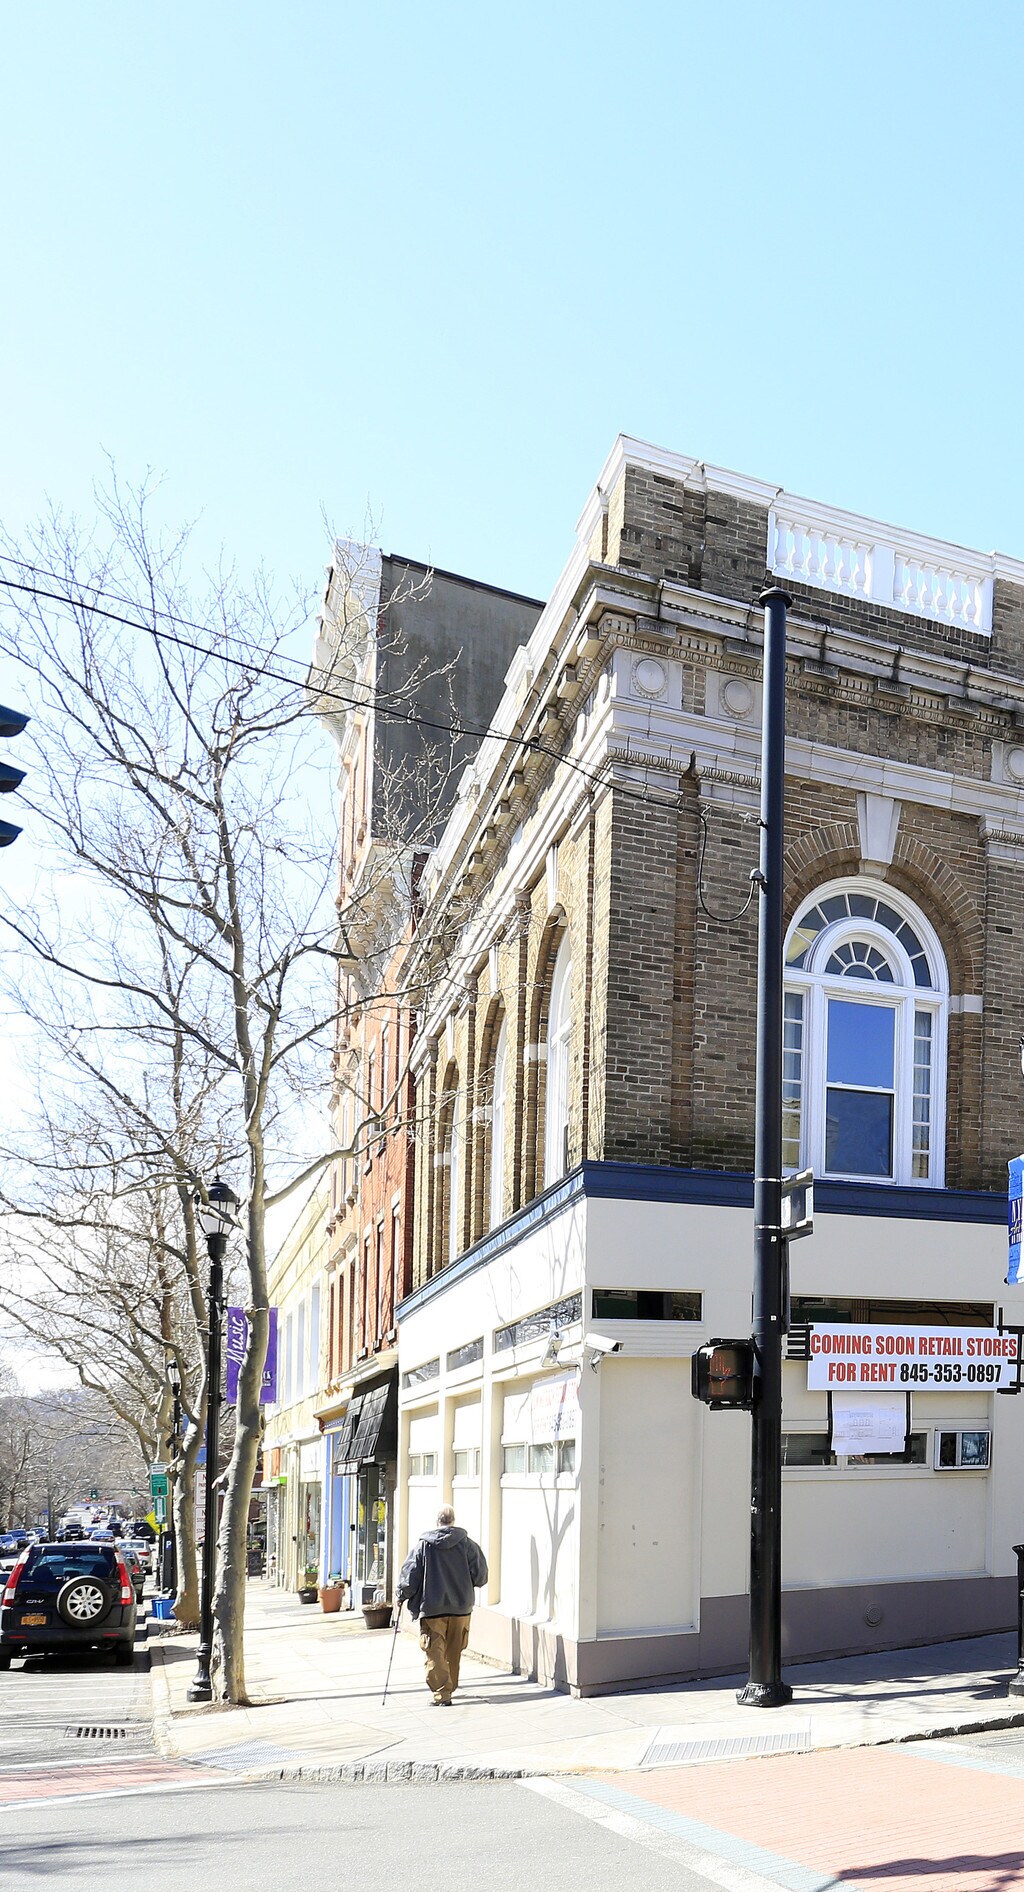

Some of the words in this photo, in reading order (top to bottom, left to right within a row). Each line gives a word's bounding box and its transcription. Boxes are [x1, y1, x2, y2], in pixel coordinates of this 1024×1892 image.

[226, 1316, 246, 1366] Music
[810, 1334, 872, 1355] COMING
[875, 1335, 915, 1355] SOON
[919, 1336, 963, 1356] RETAIL
[966, 1337, 1017, 1357] STORES
[828, 1362, 857, 1382] FOR
[860, 1362, 897, 1382] RENT
[900, 1363, 1001, 1383] 845-353-0897
